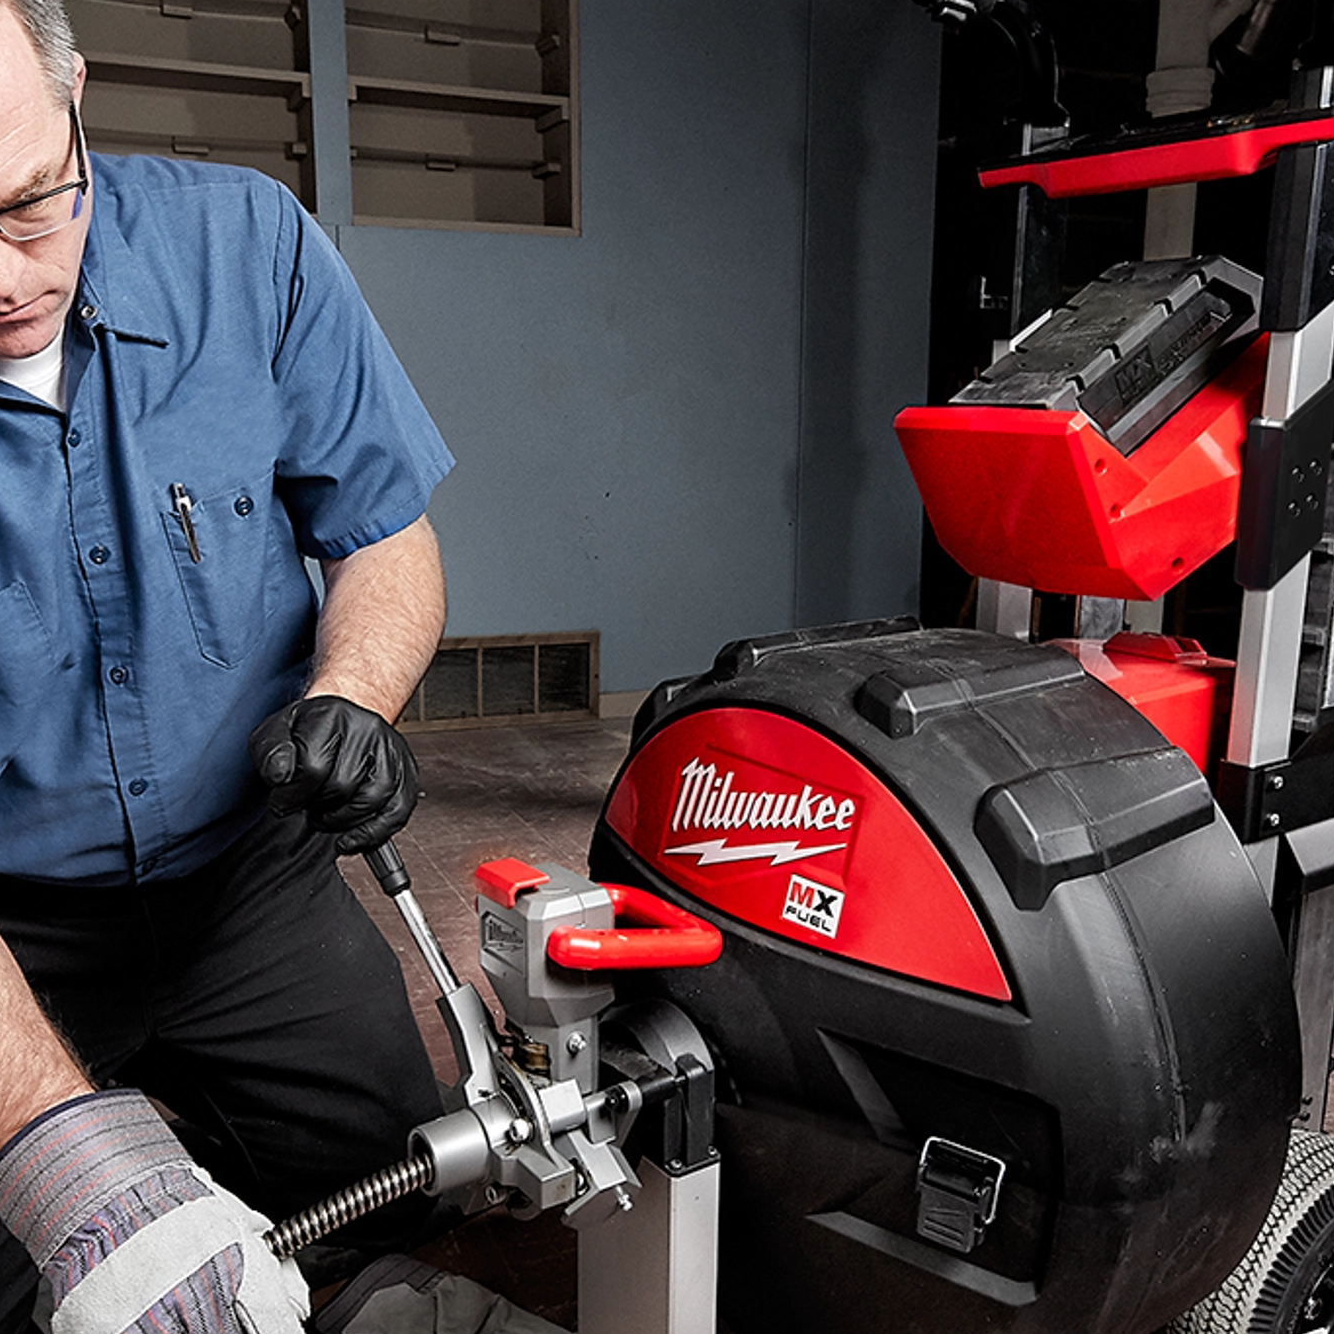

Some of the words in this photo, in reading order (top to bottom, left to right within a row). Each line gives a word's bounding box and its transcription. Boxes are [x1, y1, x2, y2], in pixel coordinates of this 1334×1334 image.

[671, 757, 856, 831] Milwaukee
[789, 880, 840, 918] MX
[786, 907, 832, 932] FUEL
